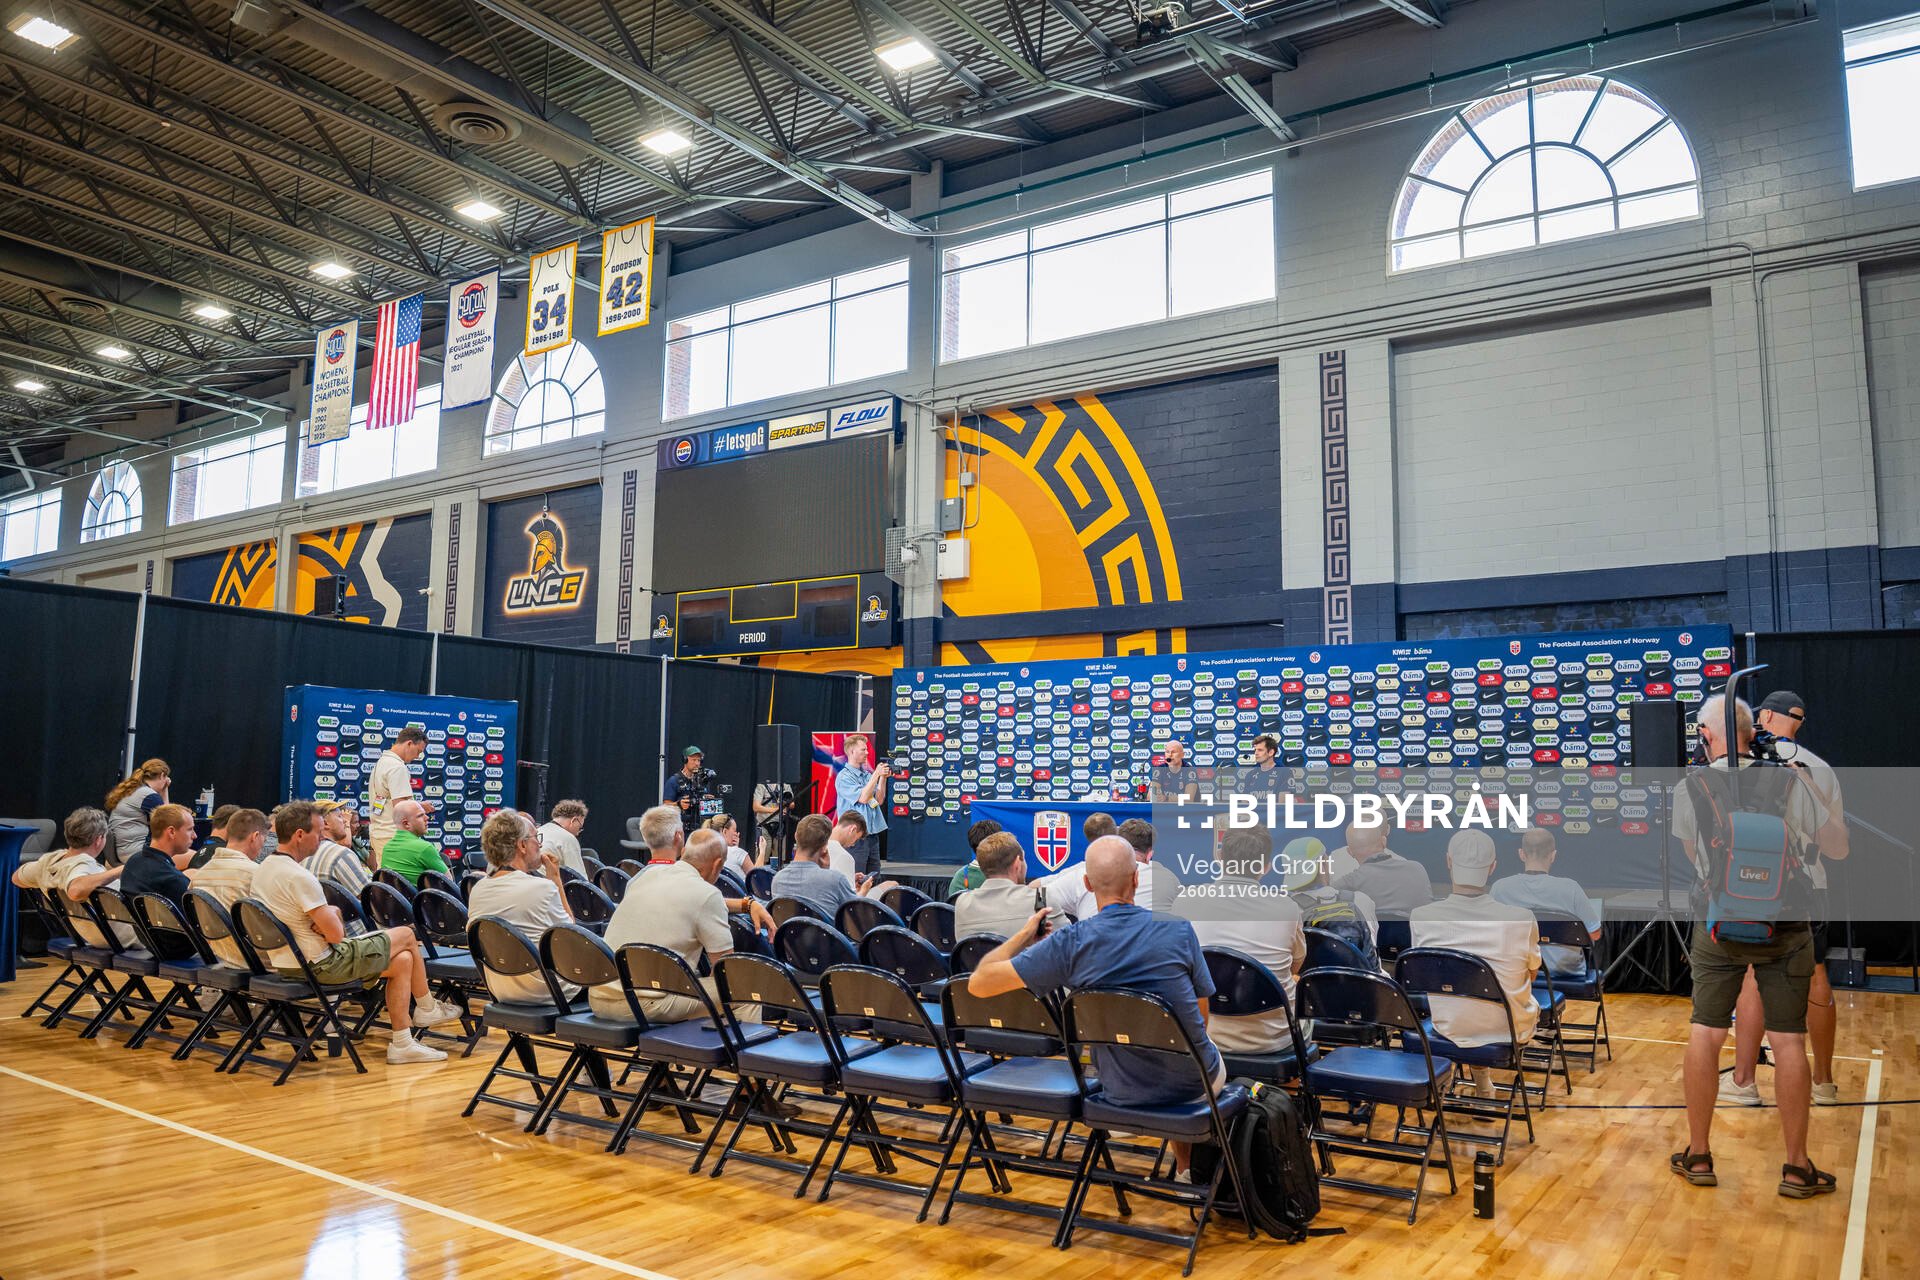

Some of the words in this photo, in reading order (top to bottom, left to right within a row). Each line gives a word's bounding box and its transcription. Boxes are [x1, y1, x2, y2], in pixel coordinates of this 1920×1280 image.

[611, 258, 642, 273] GOODSON
[543, 283, 560, 294] POLK
[606, 271, 643, 309] 42
[458, 286, 488, 320] SOCON
[532, 293, 566, 331] 34
[456, 328, 486, 344] VOLLEYBALL
[454, 345, 485, 360] CHAMPIONS
[320, 366, 348, 380] WOMEN'S
[316, 376, 349, 392] BASKETBALL
[314, 386, 350, 402] CHAMPIONS
[837, 406, 888, 426] FLOW
[770, 421, 826, 440] SPARTANS
[714, 426, 764, 453] #letsgoG
[676, 446, 692, 455] PEPSI
[509, 576, 580, 606] UNCG
[861, 610, 888, 623] UNCG
[653, 628, 674, 639] UNCG
[739, 632, 766, 644] PERIOD
[1740, 868, 1769, 880] LiveU
